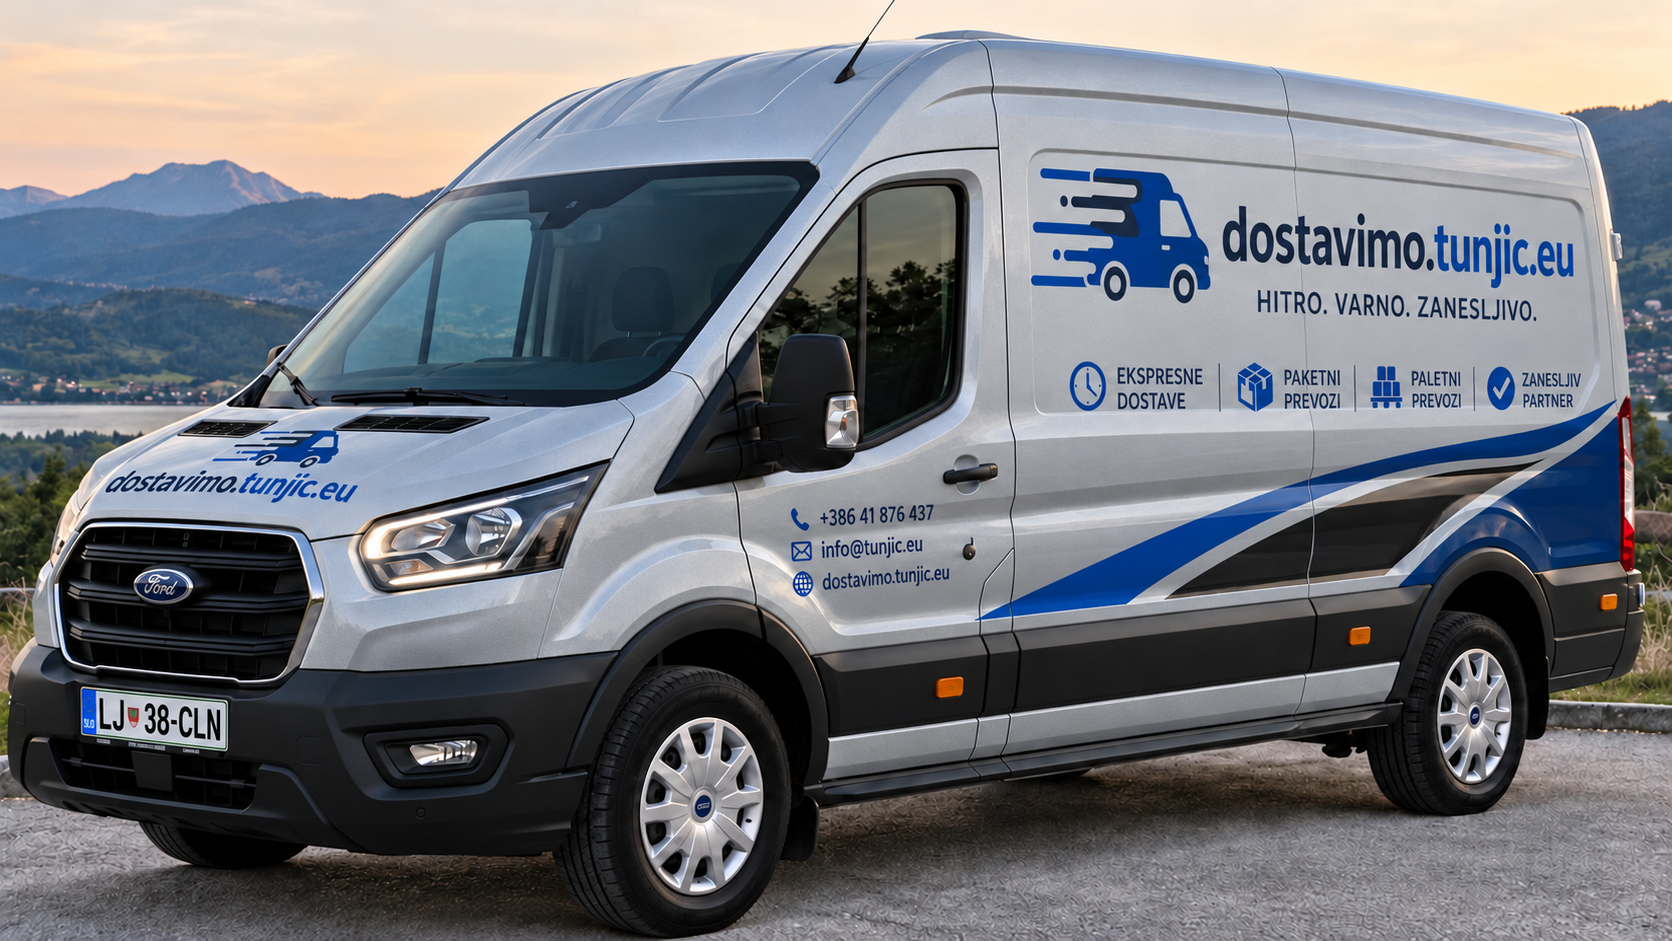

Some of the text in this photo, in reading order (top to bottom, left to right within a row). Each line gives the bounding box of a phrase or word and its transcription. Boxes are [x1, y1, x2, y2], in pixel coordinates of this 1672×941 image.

[1222, 205, 1574, 289] dostavimo.tunjic.eu
[1256, 289, 1538, 322] HITRO. VARNO. ZANESLJIVO.
[1116, 366, 1204, 386] EKSPRESNE
[1283, 369, 1342, 387] PAKETNI
[1411, 370, 1462, 387] PALETNI
[1521, 372, 1582, 388] ZANESLJIV
[1117, 392, 1187, 410] DOSTAVE
[1284, 393, 1341, 410] PREVOZI
[1412, 393, 1462, 409] PREVOZI
[1523, 393, 1574, 409] PARTNER
[105, 470, 358, 503] dostavimo.tunjic.eu
[819, 503, 935, 527] +386 41 876 437
[820, 536, 924, 559] info@tunjic.eu
[144, 574, 179, 595] Ford
[822, 565, 950, 591] dostavimo.tunjic.eu
[99, 697, 221, 741] LJ 38-CLN
